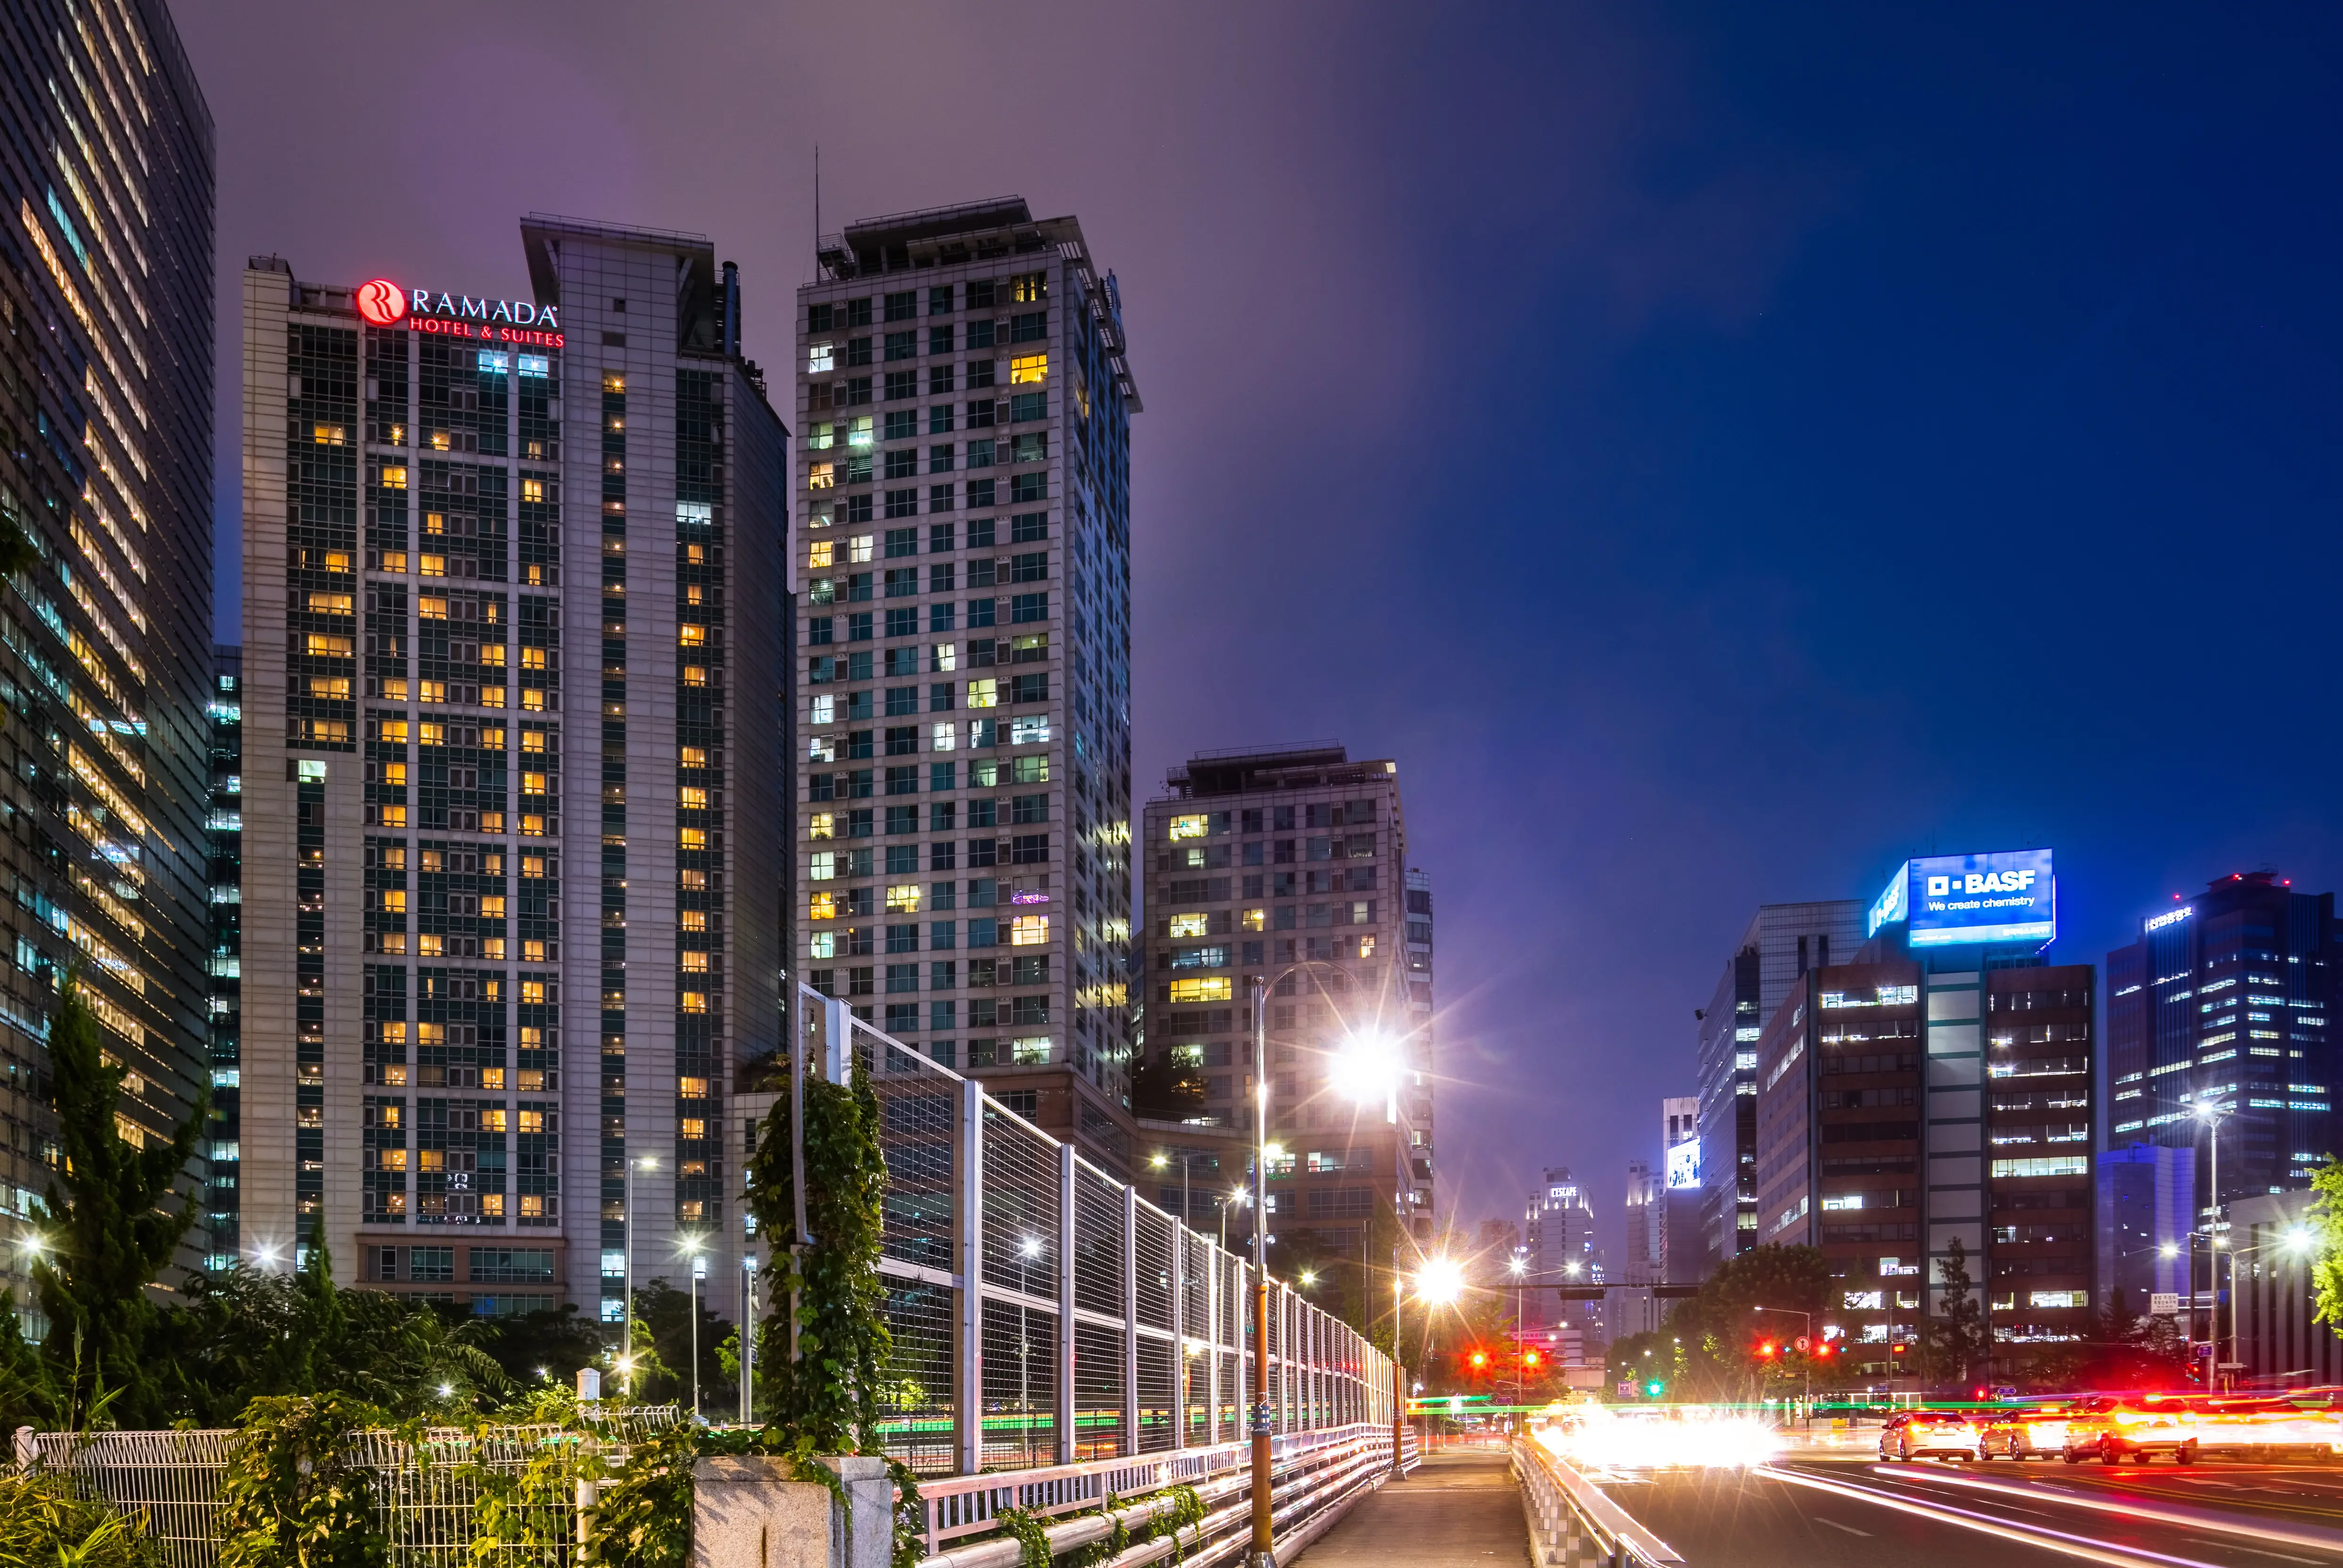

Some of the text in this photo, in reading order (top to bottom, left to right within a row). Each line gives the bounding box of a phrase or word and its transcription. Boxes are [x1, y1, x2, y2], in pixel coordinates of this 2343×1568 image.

[412, 289, 557, 328] RAMADA
[410, 317, 565, 348] HOTEL & SUITES
[1965, 869, 2036, 894] BASF
[1884, 884, 1899, 919] BASF
[1928, 896, 2035, 911] We create chemistry
